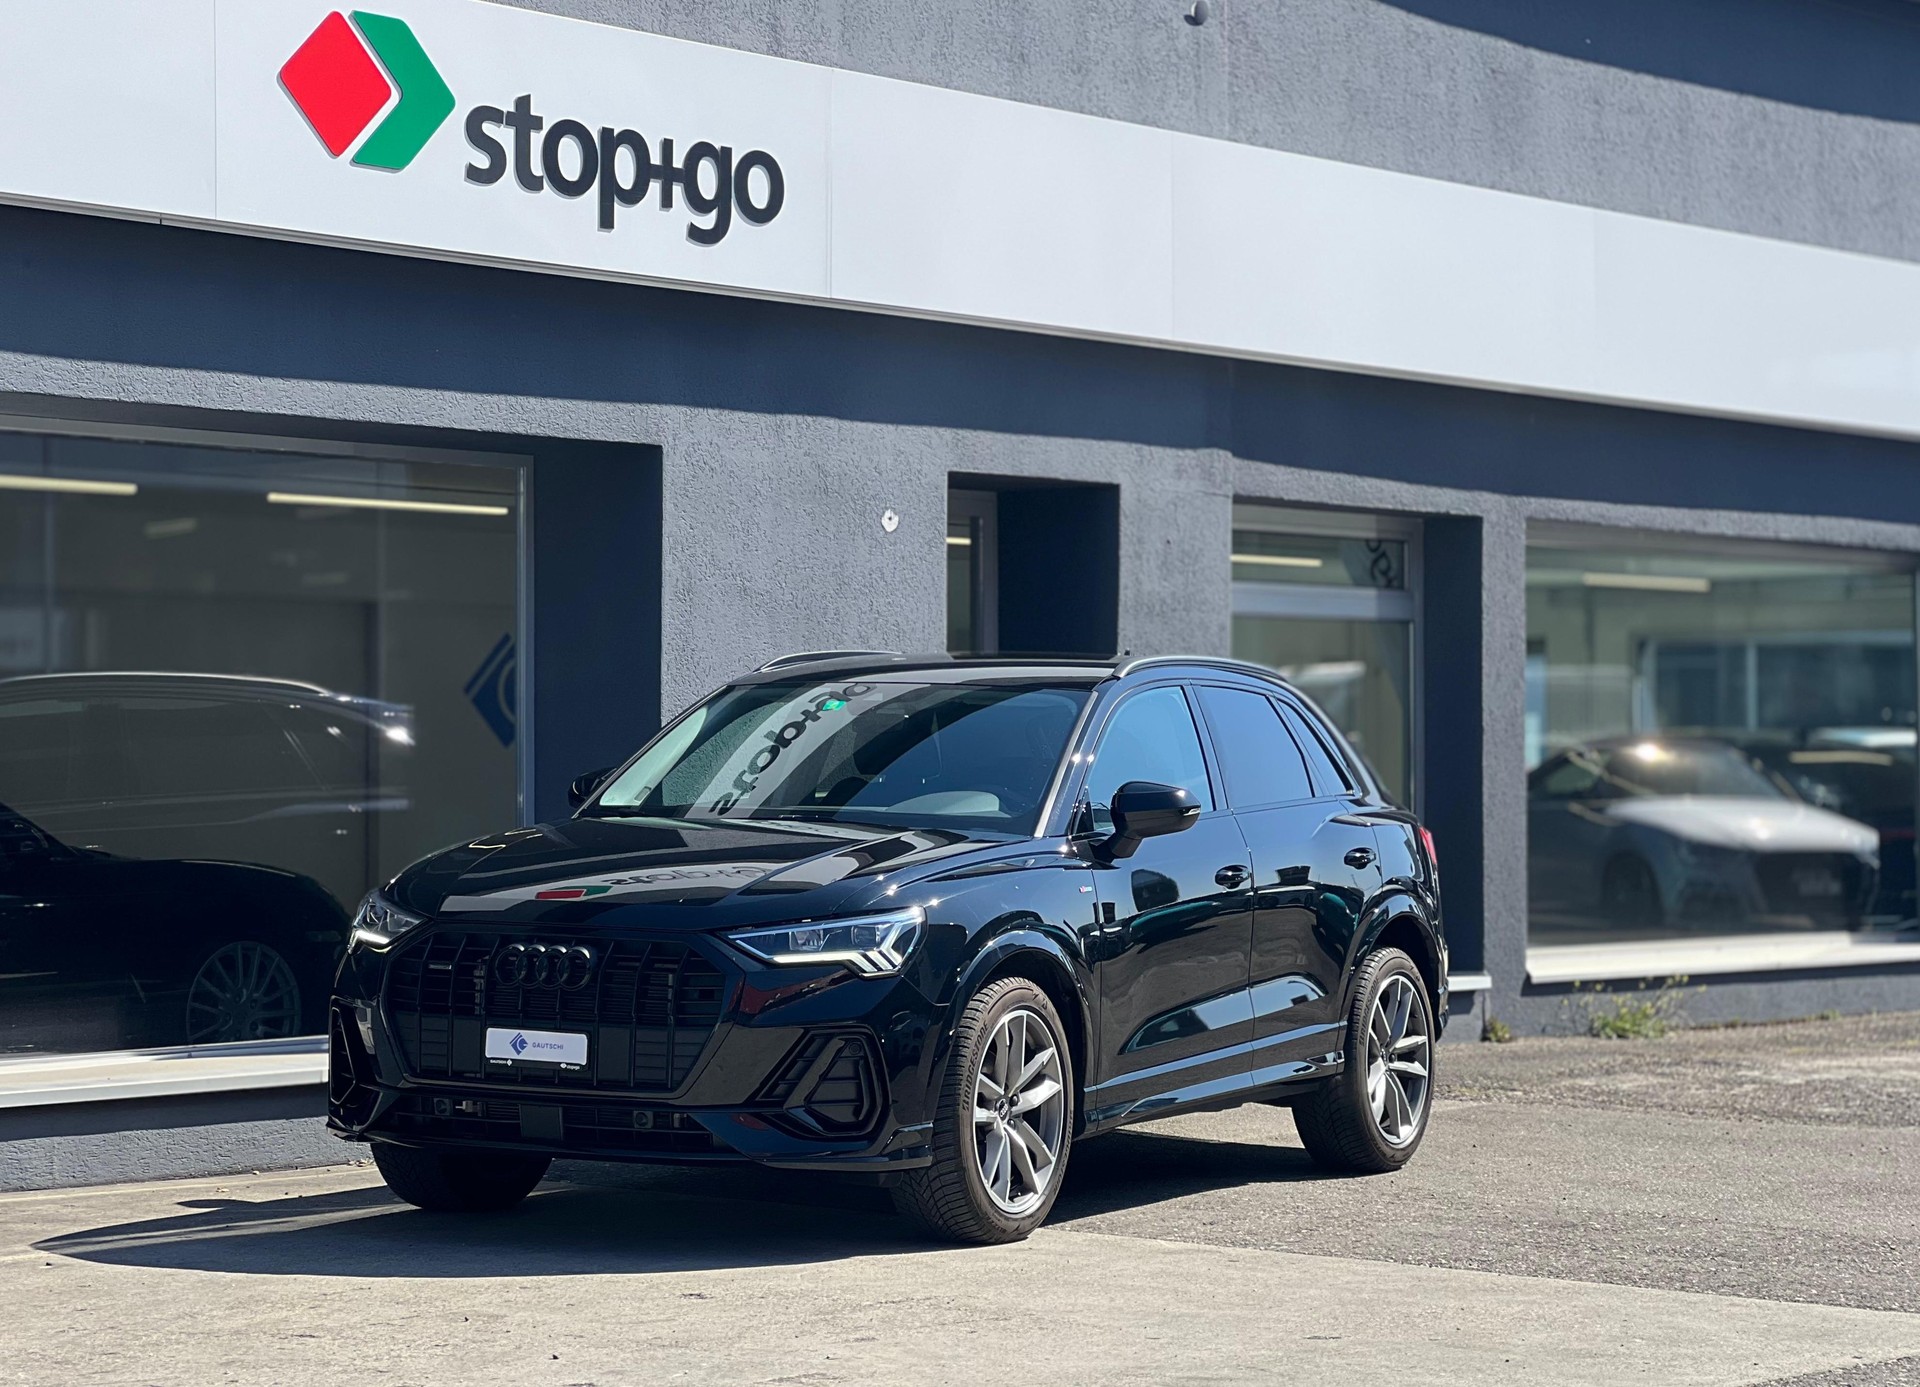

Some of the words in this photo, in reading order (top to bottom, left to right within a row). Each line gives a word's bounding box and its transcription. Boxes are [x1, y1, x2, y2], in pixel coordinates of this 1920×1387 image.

[464, 94, 784, 247] stop+go
[531, 1041, 564, 1050] GAUTSCHI
[961, 1020, 989, 1112] BRIDGESTONE
